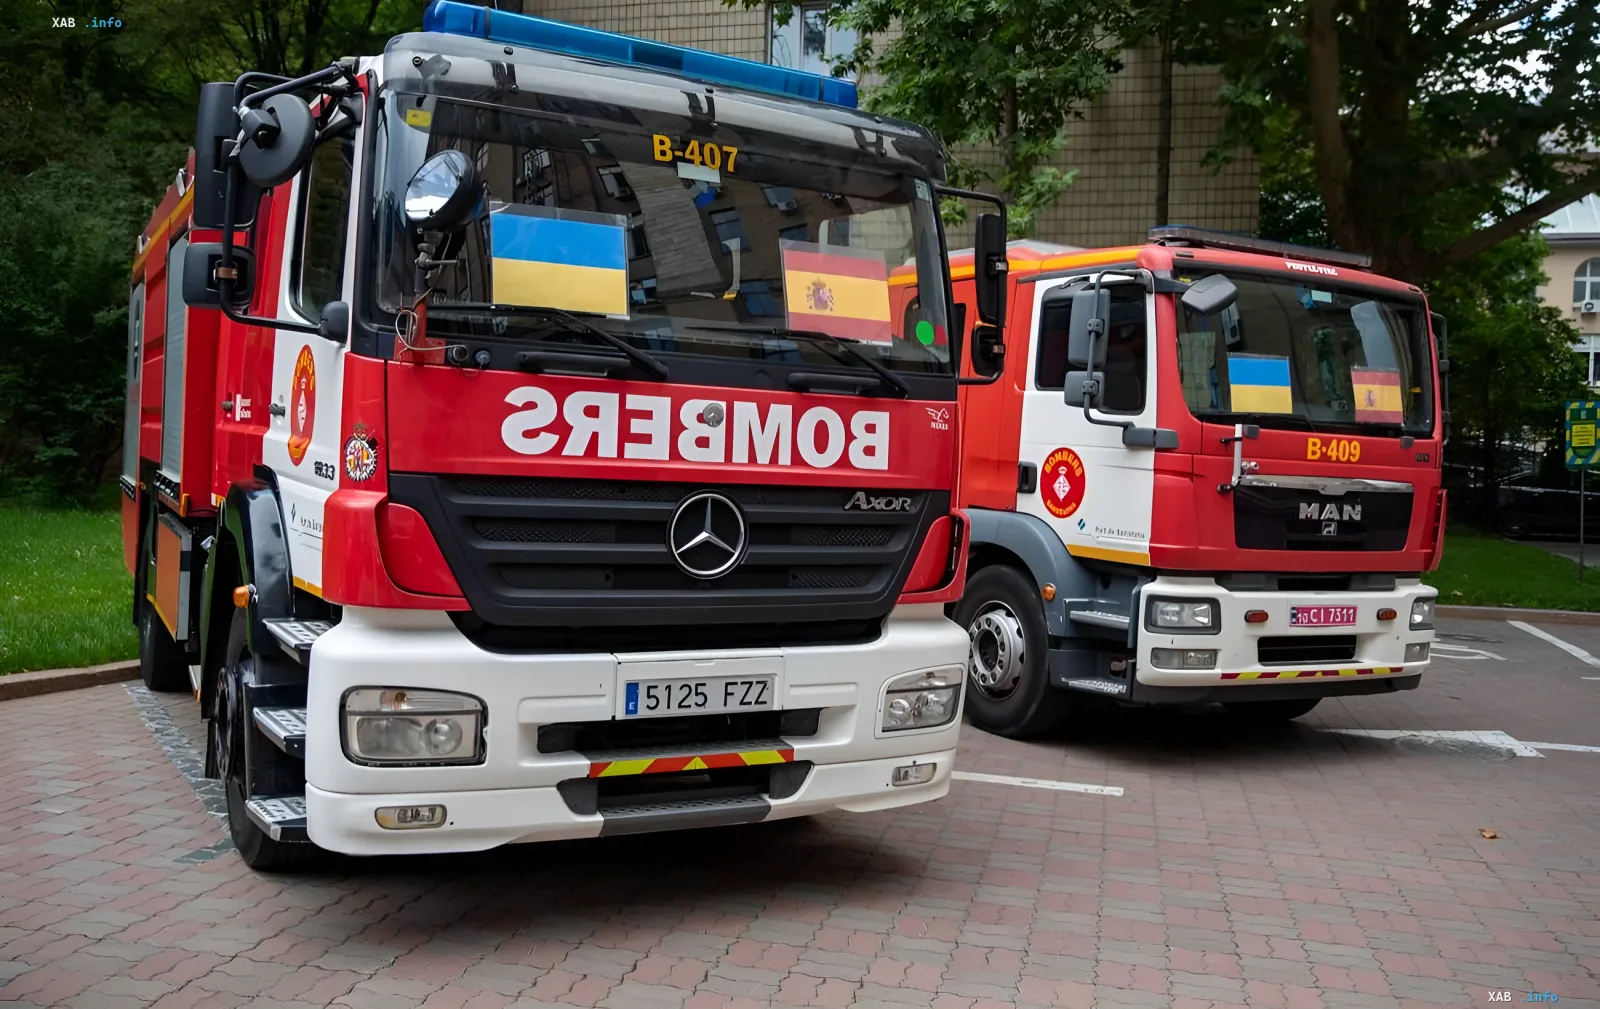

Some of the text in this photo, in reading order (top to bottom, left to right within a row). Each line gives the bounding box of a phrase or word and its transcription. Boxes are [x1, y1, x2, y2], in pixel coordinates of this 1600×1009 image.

[652, 133, 738, 173] B-407
[1298, 502, 1362, 521] MAN
[628, 681, 768, 711] E 5125 FZZ
